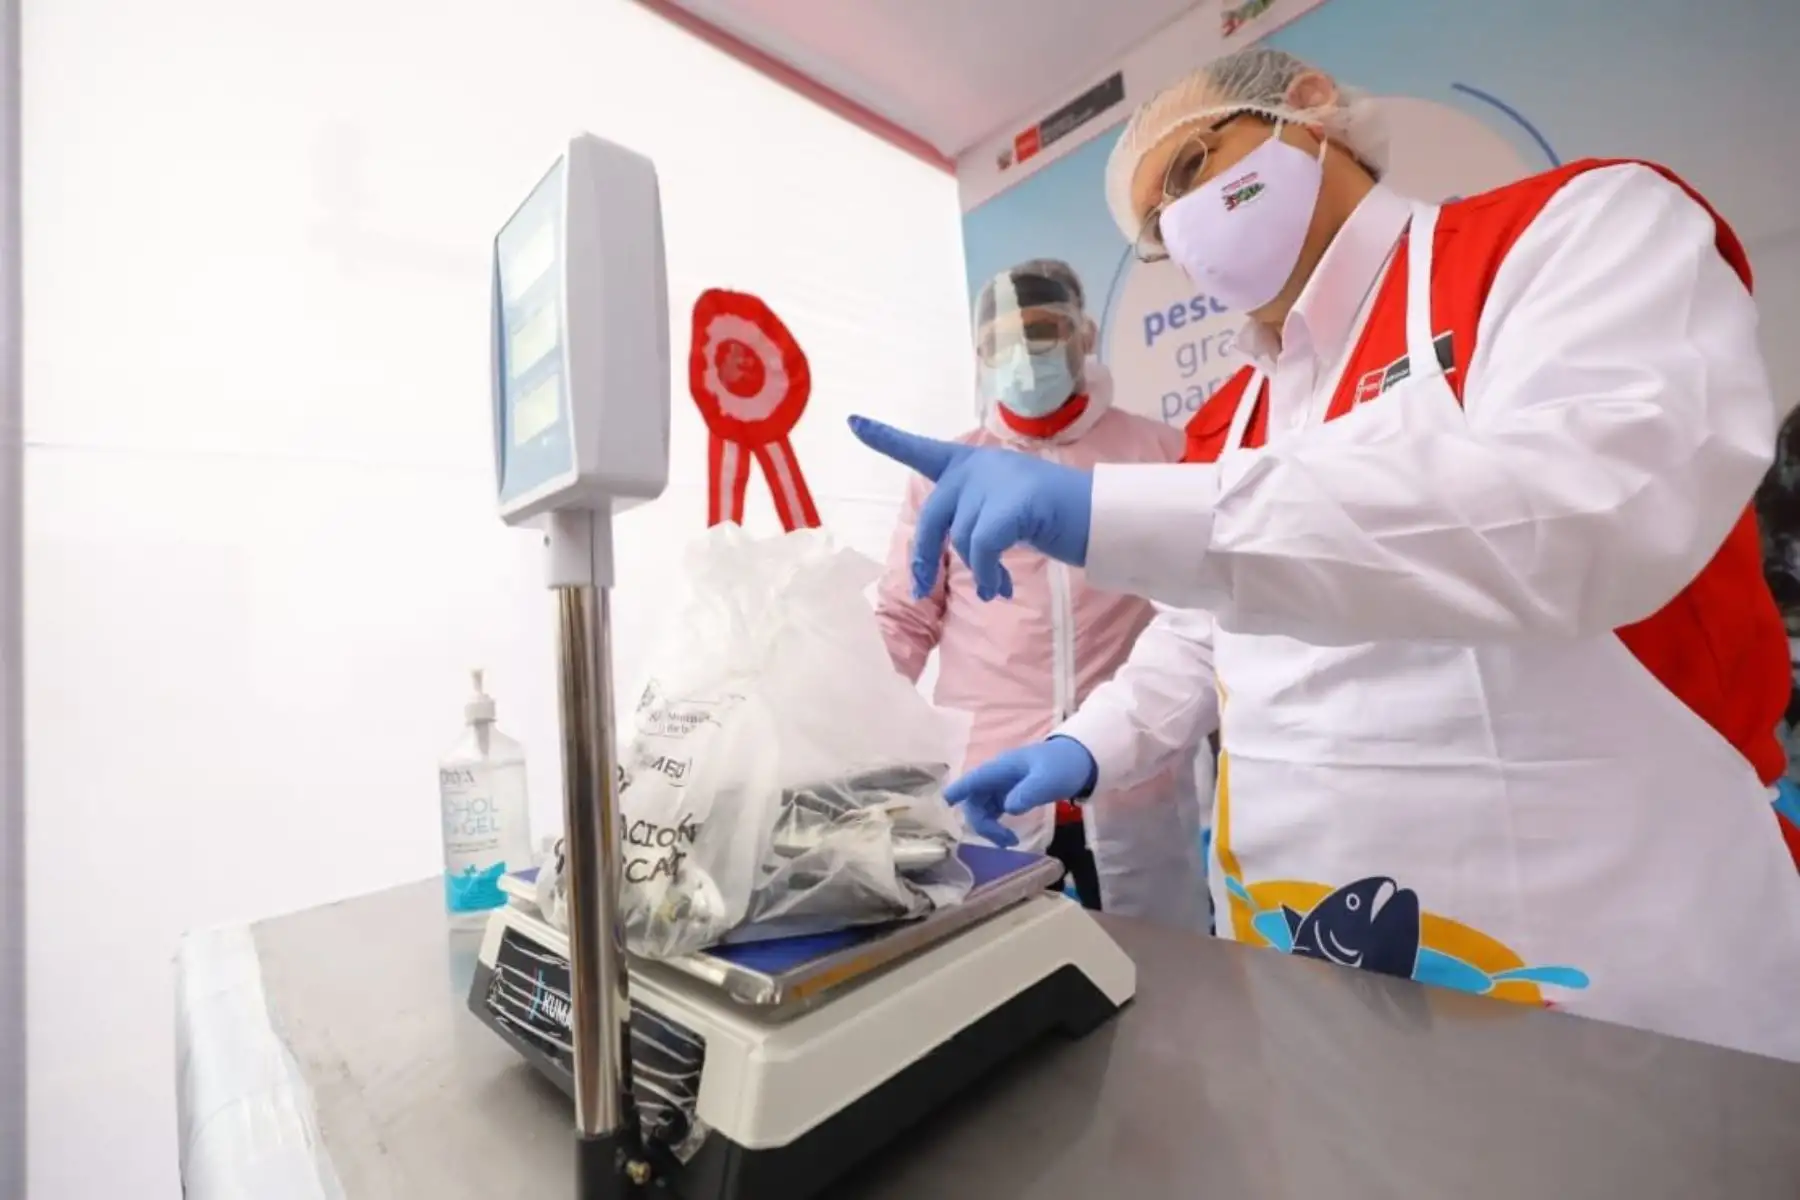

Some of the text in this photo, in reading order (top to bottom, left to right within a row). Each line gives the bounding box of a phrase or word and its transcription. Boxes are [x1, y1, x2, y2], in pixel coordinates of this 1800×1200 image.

[1143, 292, 1229, 347] pesc
[1175, 327, 1236, 379] gra
[1160, 376, 1223, 425] par
